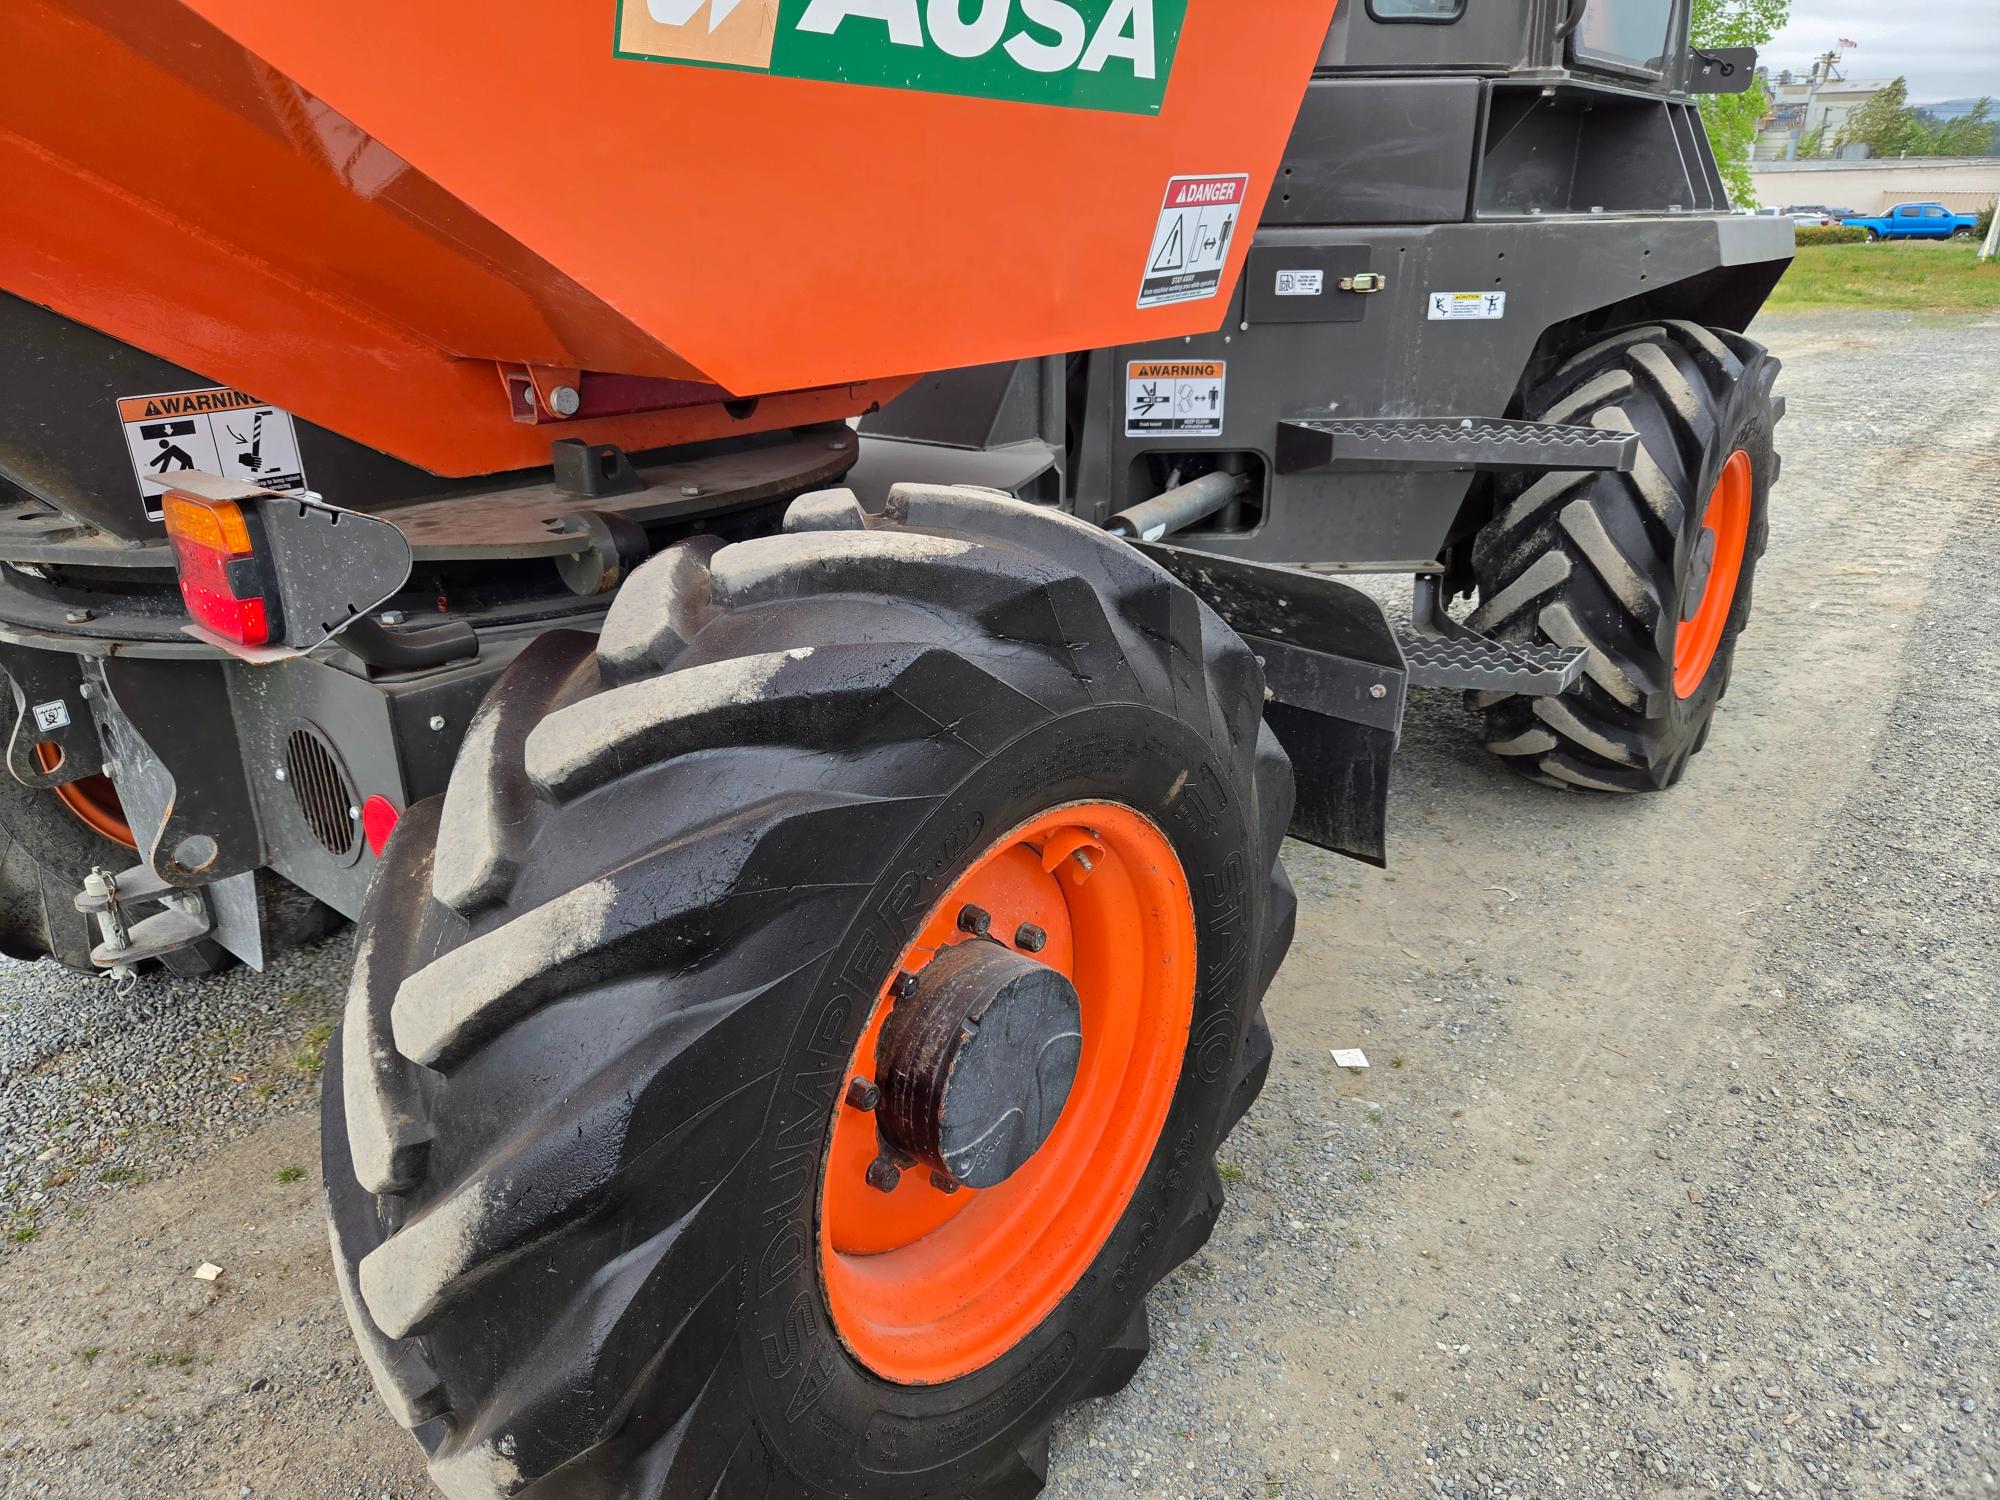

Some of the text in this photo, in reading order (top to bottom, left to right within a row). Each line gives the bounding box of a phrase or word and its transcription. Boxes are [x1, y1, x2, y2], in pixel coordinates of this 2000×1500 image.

[1186, 182, 1236, 202] DANGER
[1172, 276, 1182, 285] STAY
[1149, 365, 1215, 376] WARNING
[758, 869, 926, 1299] DUMPER
